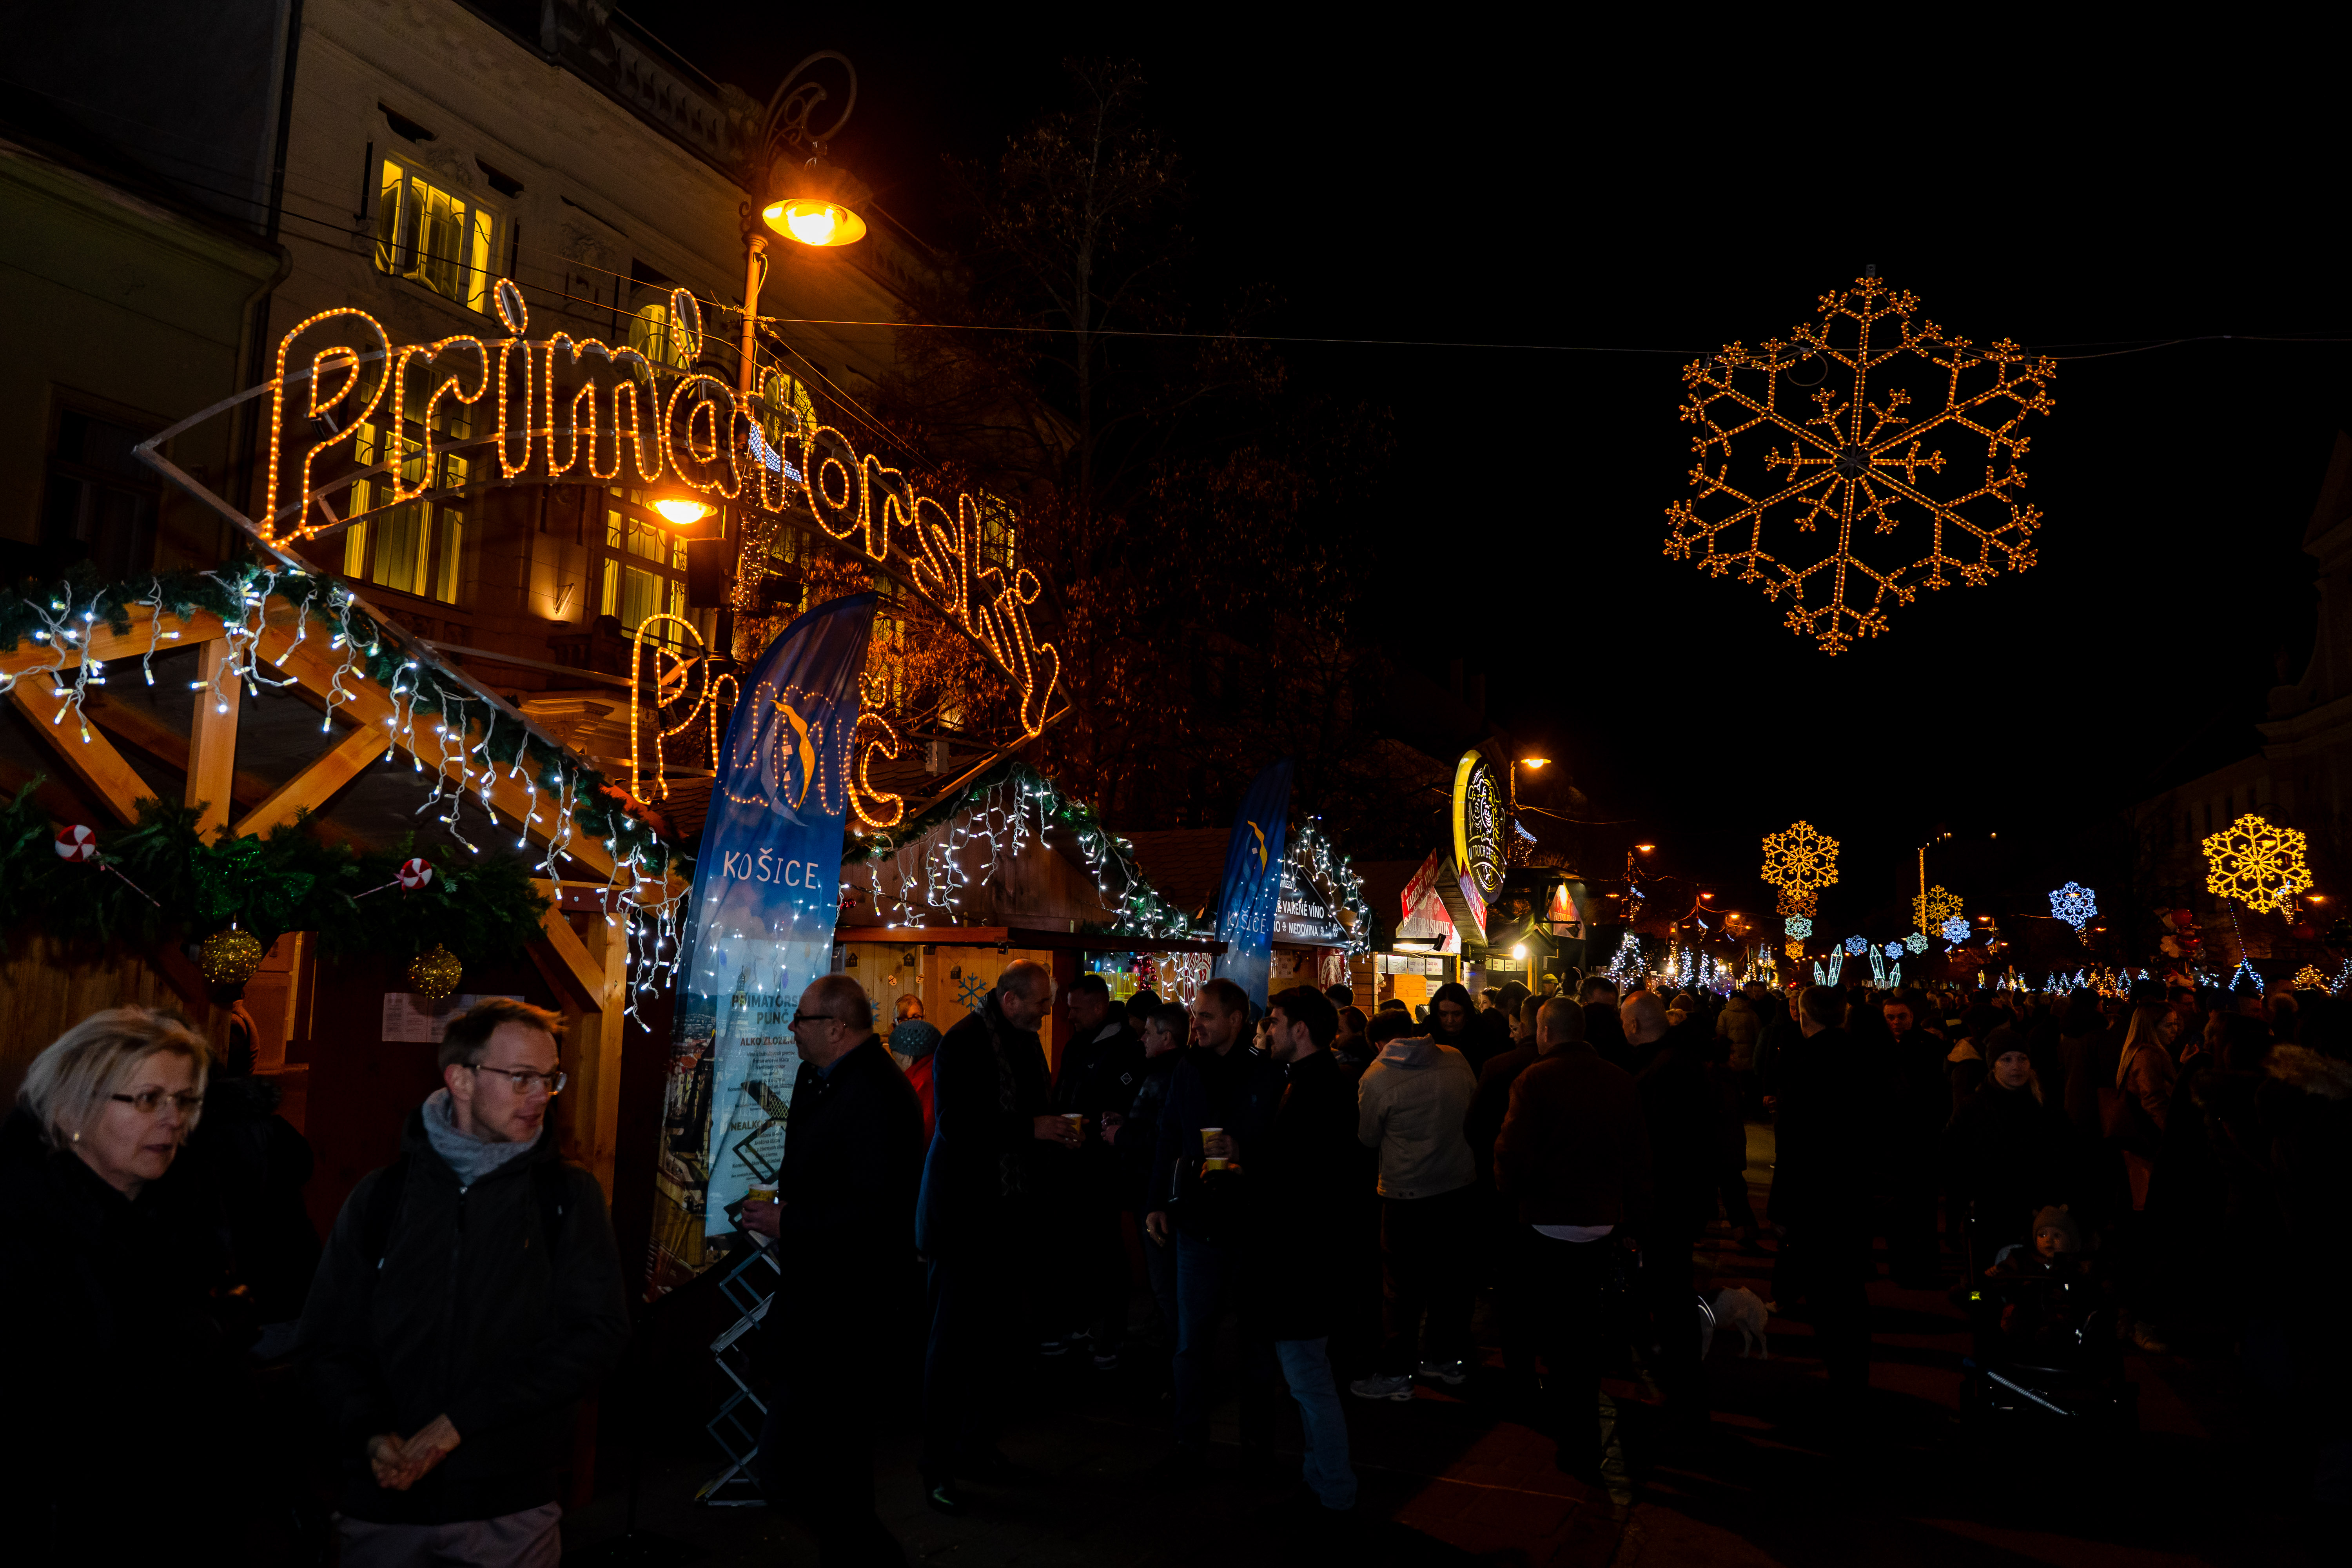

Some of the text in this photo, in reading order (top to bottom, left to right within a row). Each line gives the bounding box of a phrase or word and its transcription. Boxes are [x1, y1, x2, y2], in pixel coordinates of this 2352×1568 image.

[1472, 844, 1486, 858] TROCH
[723, 847, 818, 889] KOŠICE
[1463, 871, 1484, 925] MEDOVINA
[1282, 900, 1308, 916] VARENÉ
[1308, 902, 1324, 919] VÍNO
[1227, 909, 1267, 934] KOŠICE
[1289, 922, 1318, 936] MEDOVINA
[1418, 917, 1450, 936] PRASIATOK
[731, 993, 799, 1007] PRIMÁTORS
[757, 1008, 789, 1025] PUNČ
[740, 1038, 762, 1046] ALKO
